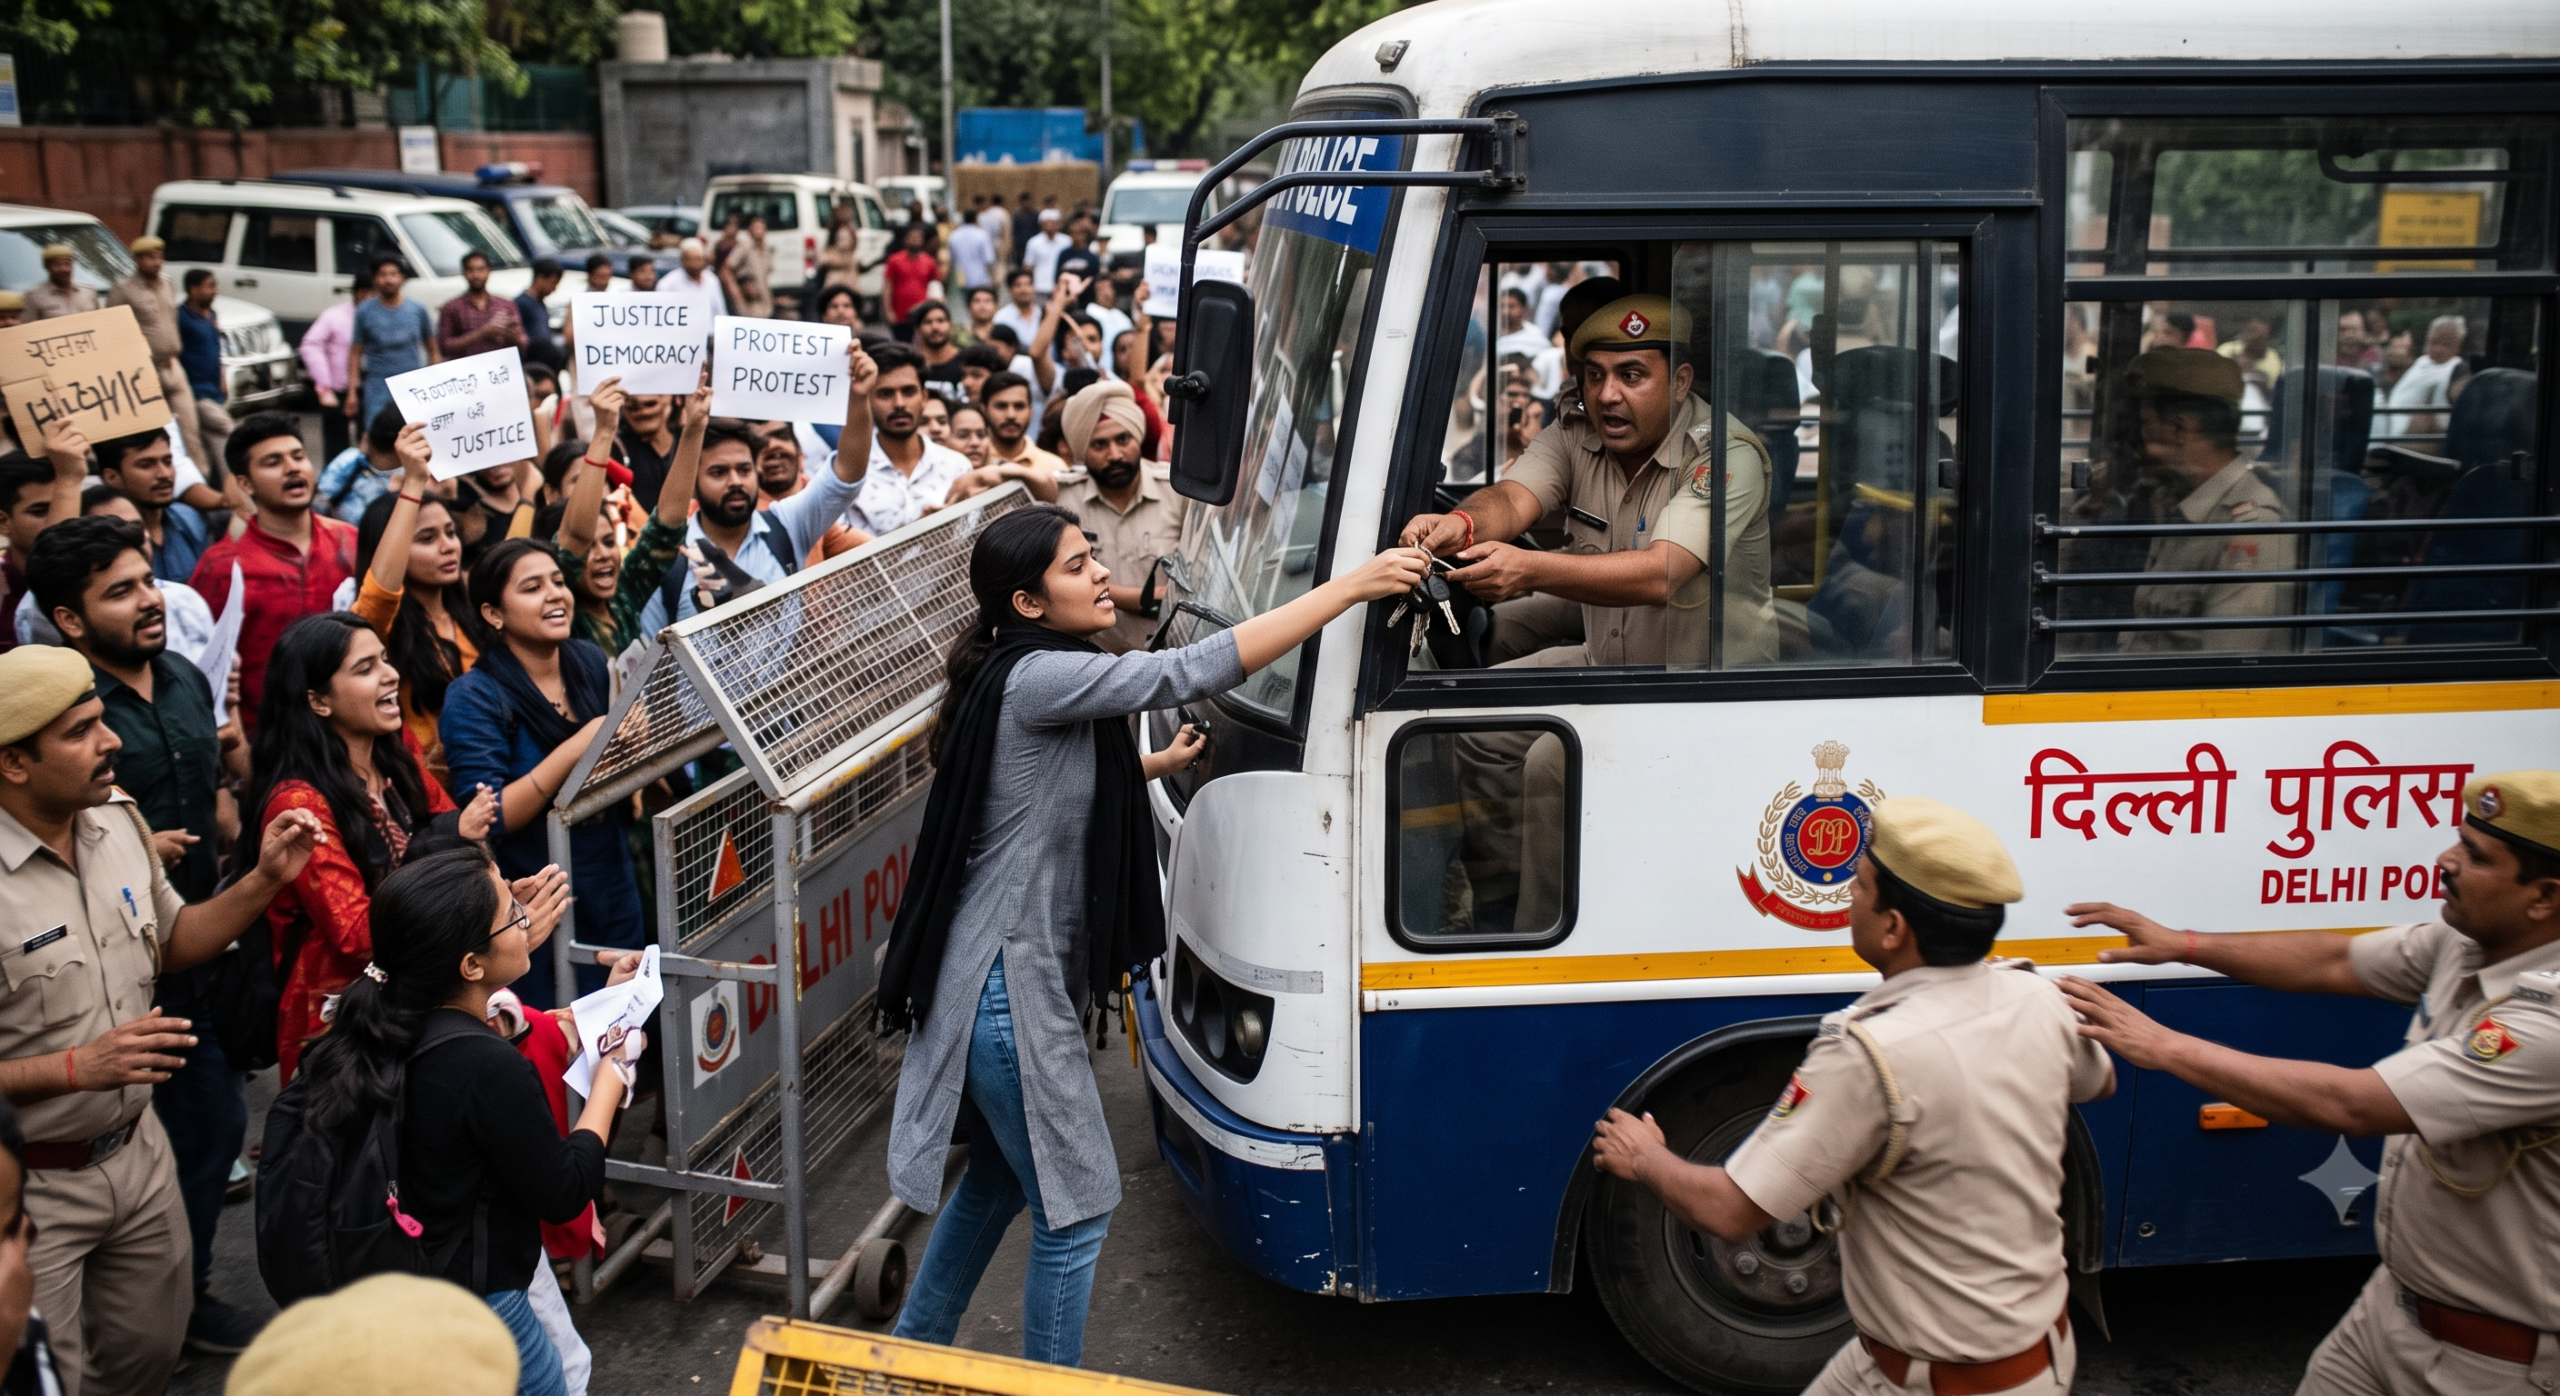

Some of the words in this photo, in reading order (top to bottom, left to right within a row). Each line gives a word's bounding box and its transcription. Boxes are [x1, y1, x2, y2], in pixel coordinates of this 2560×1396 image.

[1284, 136, 1379, 225] POLICE
[592, 305, 688, 327] JUSTICE
[585, 344, 700, 365] DEMOCRACY
[734, 328, 833, 356] PROTEST
[732, 367, 837, 396] PROTEST
[451, 421, 526, 458] JUSTICE
[2024, 742, 2237, 841] दिल्ली
[2265, 740, 2475, 859] पुलिस
[2261, 867, 2368, 904] DELHI
[747, 888, 853, 1035] DLHI
